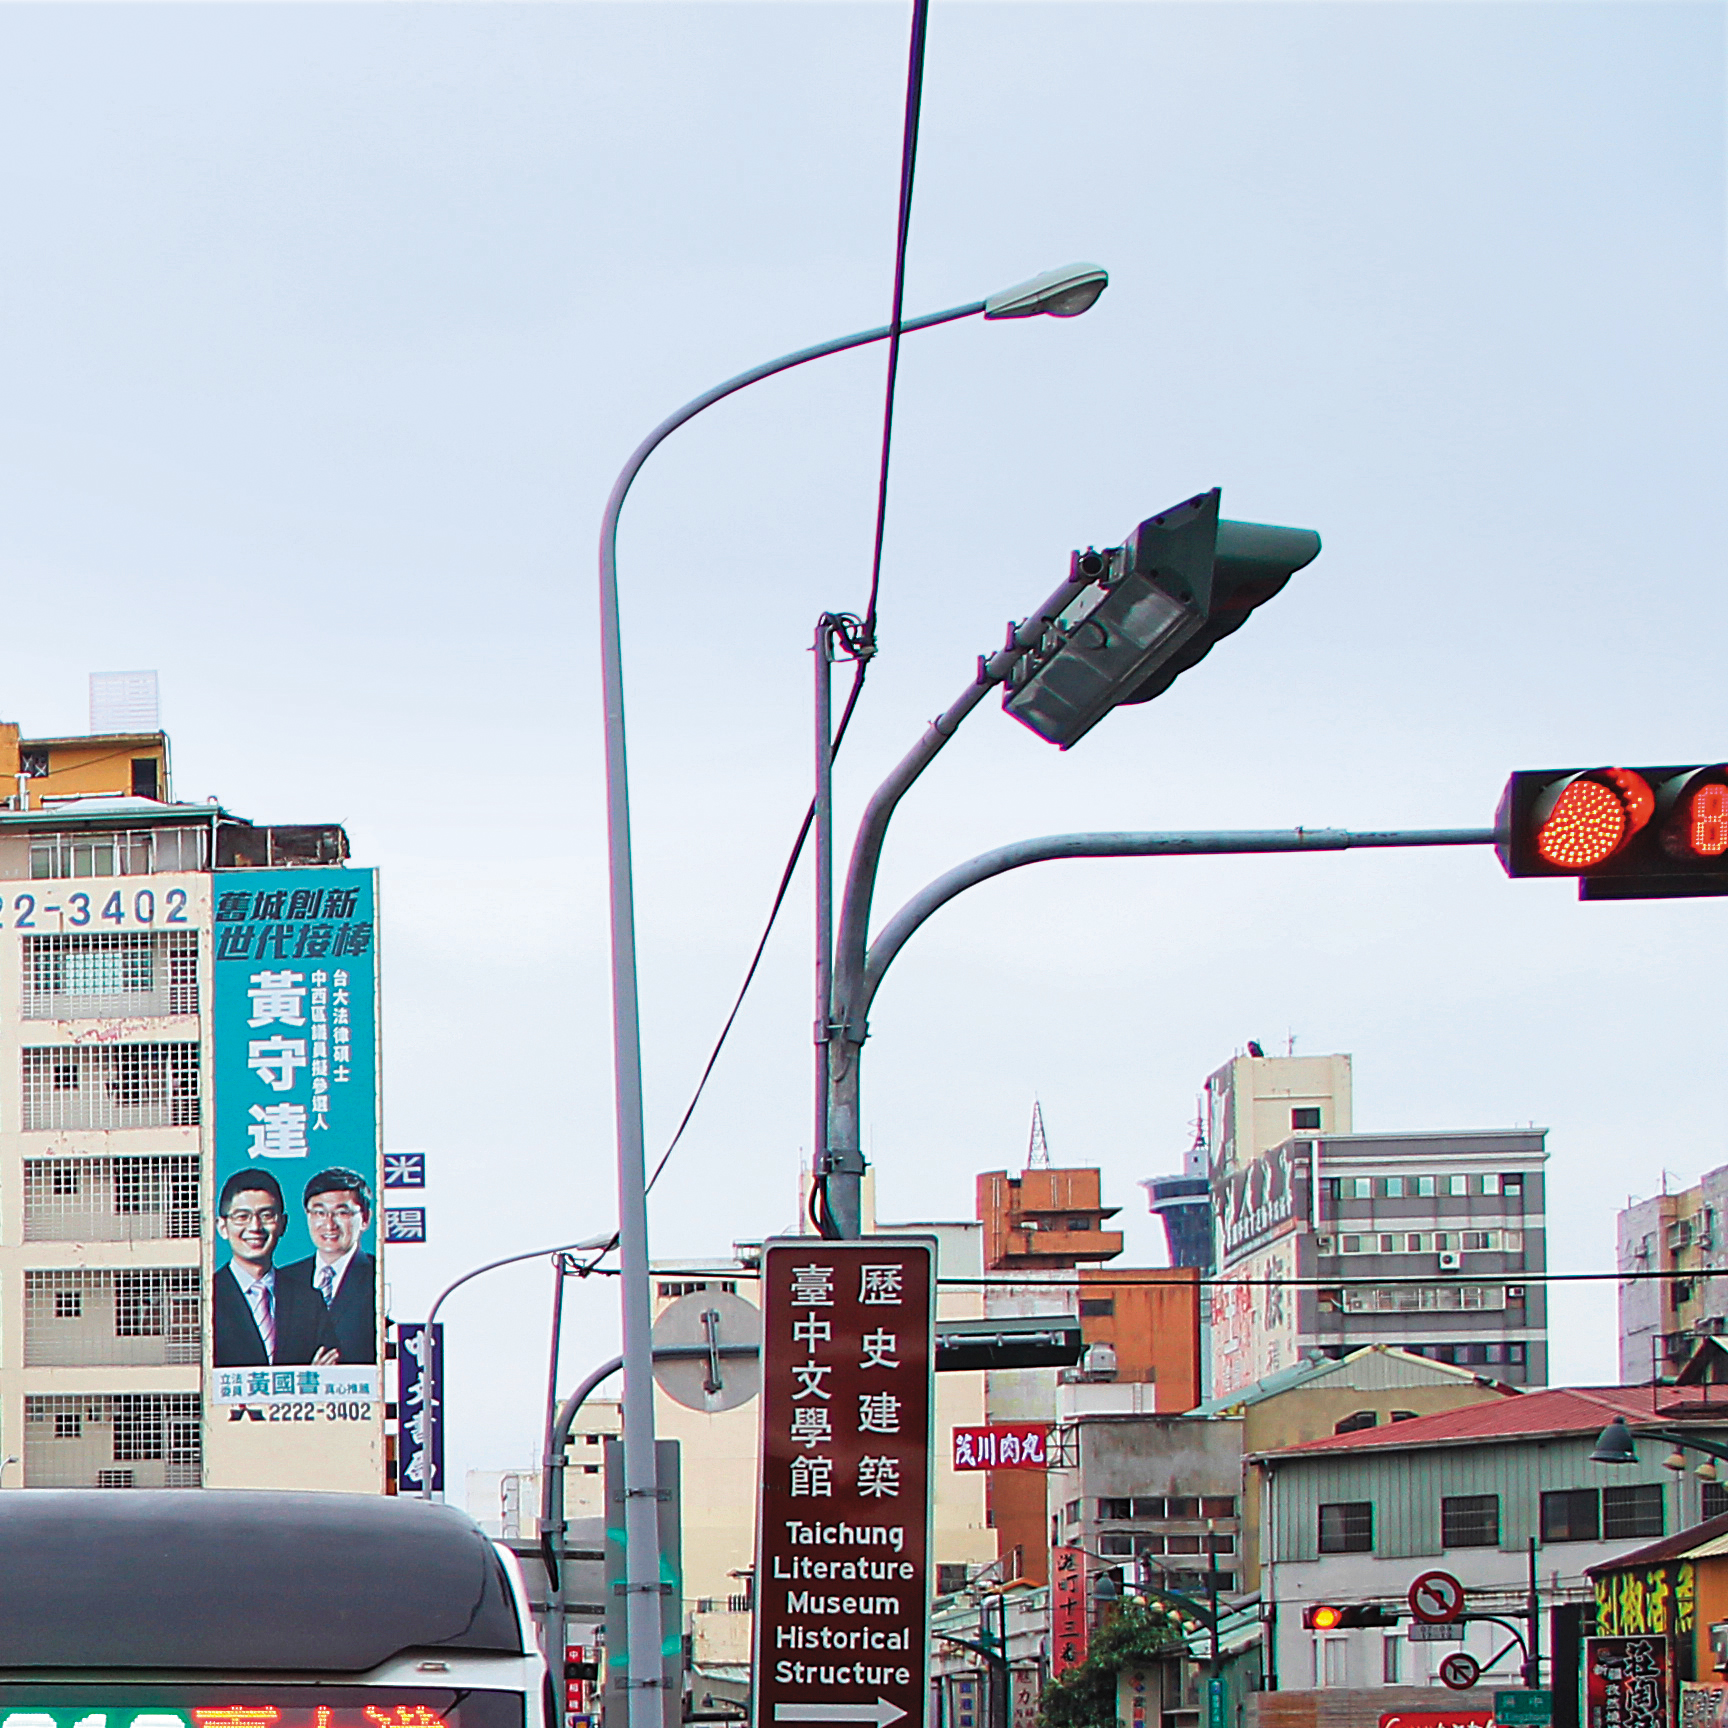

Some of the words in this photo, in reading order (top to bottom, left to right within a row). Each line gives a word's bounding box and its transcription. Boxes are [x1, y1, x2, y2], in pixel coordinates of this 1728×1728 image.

[216, 887, 359, 922] 舊城創新
[217, 922, 373, 961] 世代接棒
[247, 970, 308, 1160] 黃守達
[385, 1157, 423, 1239] 光陽
[247, 1371, 320, 1396] 黃國書
[790, 1263, 835, 1497] 臺中文學館
[858, 1264, 903, 1498] 歷史建築
[268, 1402, 372, 1422] 2222-3402
[955, 1432, 1045, 1467] 茂川肉丸
[785, 1521, 905, 1553] Taichung
[773, 1556, 914, 1580] Literature
[787, 1591, 900, 1615] Museum
[776, 1626, 910, 1650] Historical
[774, 1660, 911, 1685] Structure
